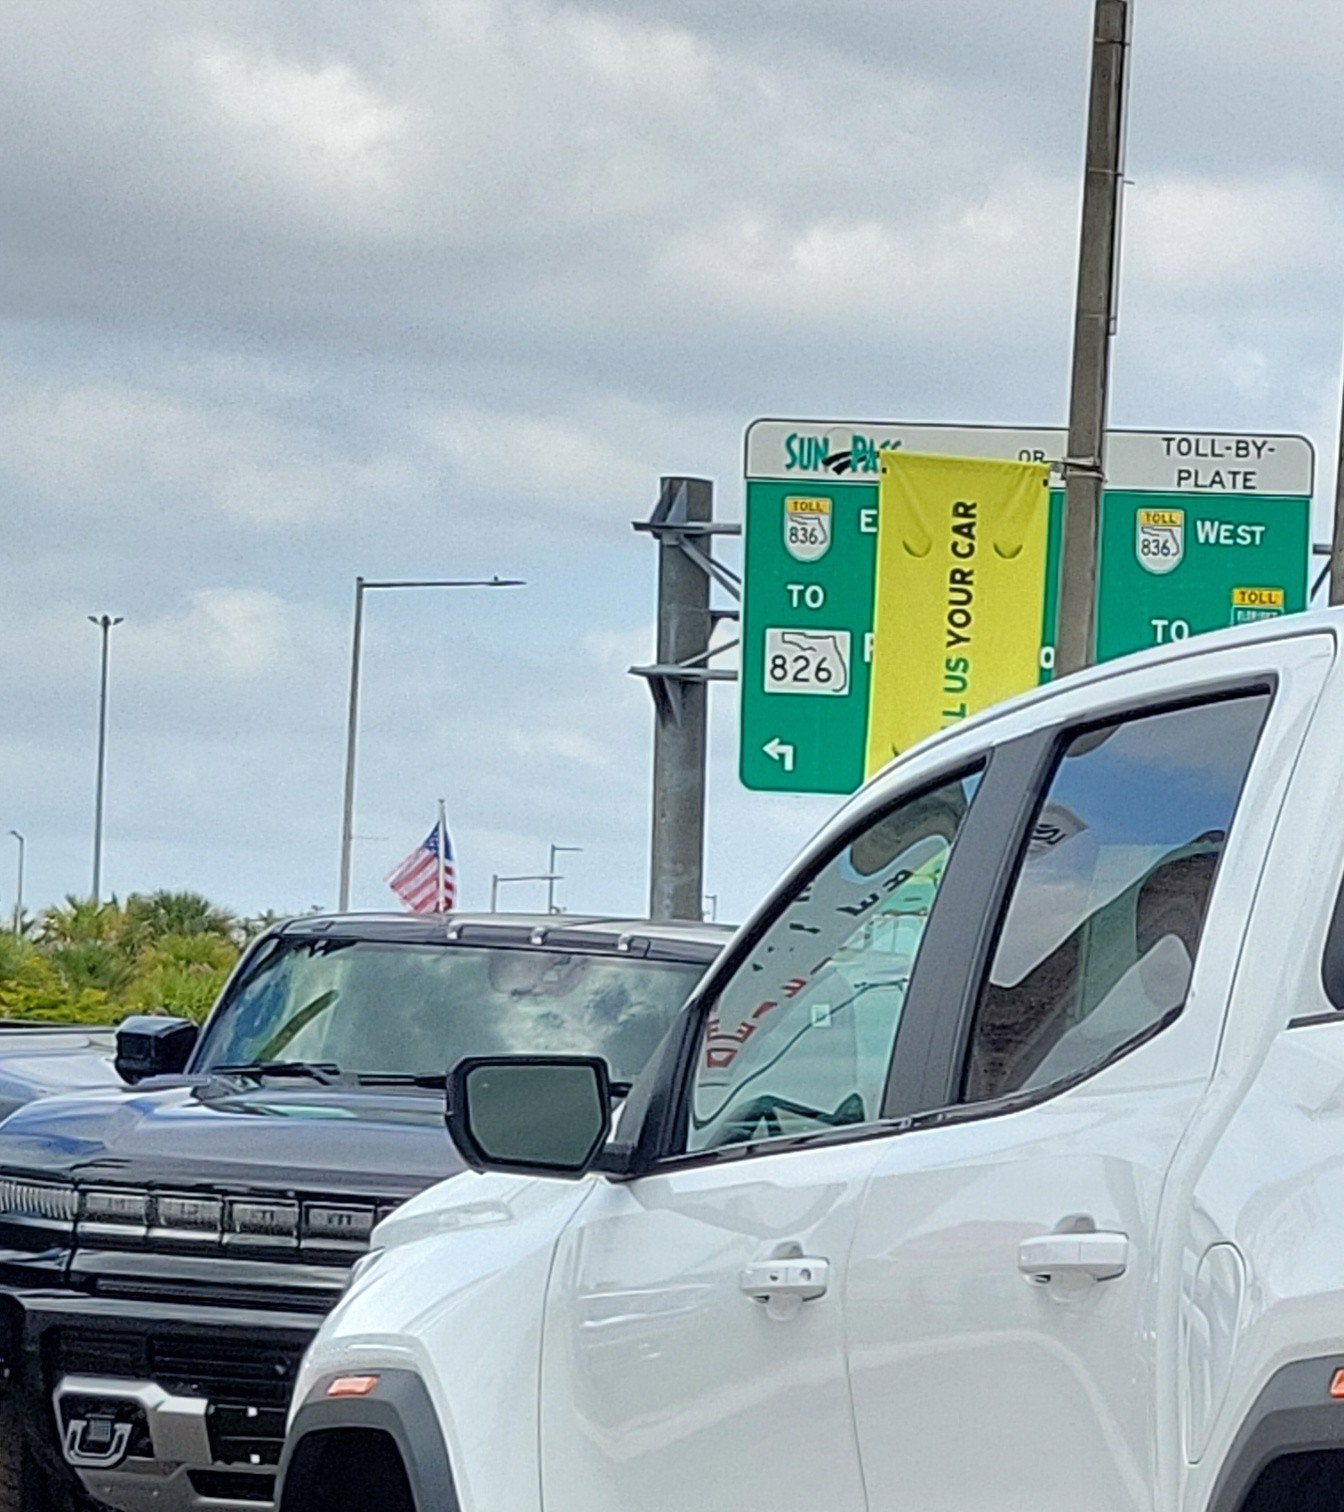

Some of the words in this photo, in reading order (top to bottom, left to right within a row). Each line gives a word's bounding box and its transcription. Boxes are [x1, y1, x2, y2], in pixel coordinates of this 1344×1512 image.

[1162, 437, 1276, 459] TOLL-BY-
[1176, 469, 1257, 489] PLATE
[793, 501, 823, 512] TOLL
[1145, 513, 1177, 524] TOLL
[789, 527, 818, 544] 836
[951, 501, 977, 559] CAR
[1196, 520, 1265, 545] WEST
[1141, 539, 1171, 556] 836
[787, 584, 824, 608] TO
[1239, 590, 1277, 604] TOLL
[946, 568, 974, 648] YOUR
[1151, 619, 1189, 641] TO
[770, 655, 832, 683] 826
[942, 657, 970, 693] US
